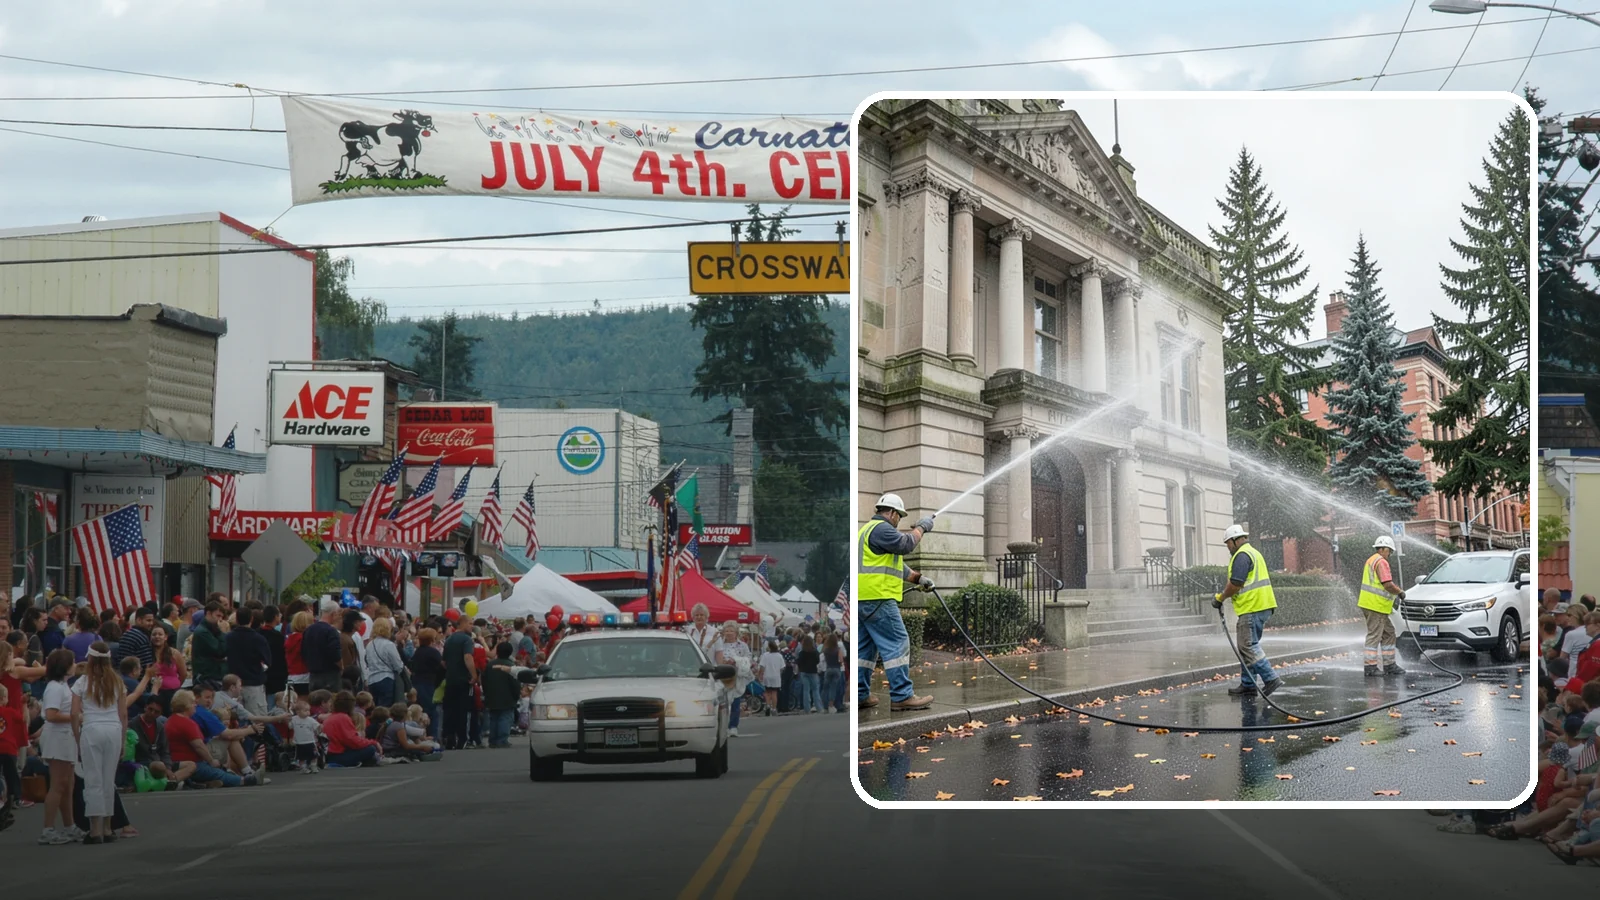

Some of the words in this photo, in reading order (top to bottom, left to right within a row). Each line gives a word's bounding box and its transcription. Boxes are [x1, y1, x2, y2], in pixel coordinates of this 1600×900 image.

[695, 121, 850, 150] Carnat
[481, 141, 605, 192] JULY
[632, 150, 746, 198] 4th.
[697, 254, 850, 280] CROSSWA
[283, 380, 373, 419] ACE
[405, 409, 452, 422] CEDAR
[283, 421, 370, 436] Hardware
[416, 428, 477, 447] Coca-Cola
[353, 467, 386, 479] Simpl
[83, 485, 93, 494] St.
[95, 485, 124, 494] Vincent
[126, 486, 136, 494] de
[137, 486, 155, 495] Paul
[688, 526, 741, 535] CRNATION
[699, 535, 730, 543] GLASS
